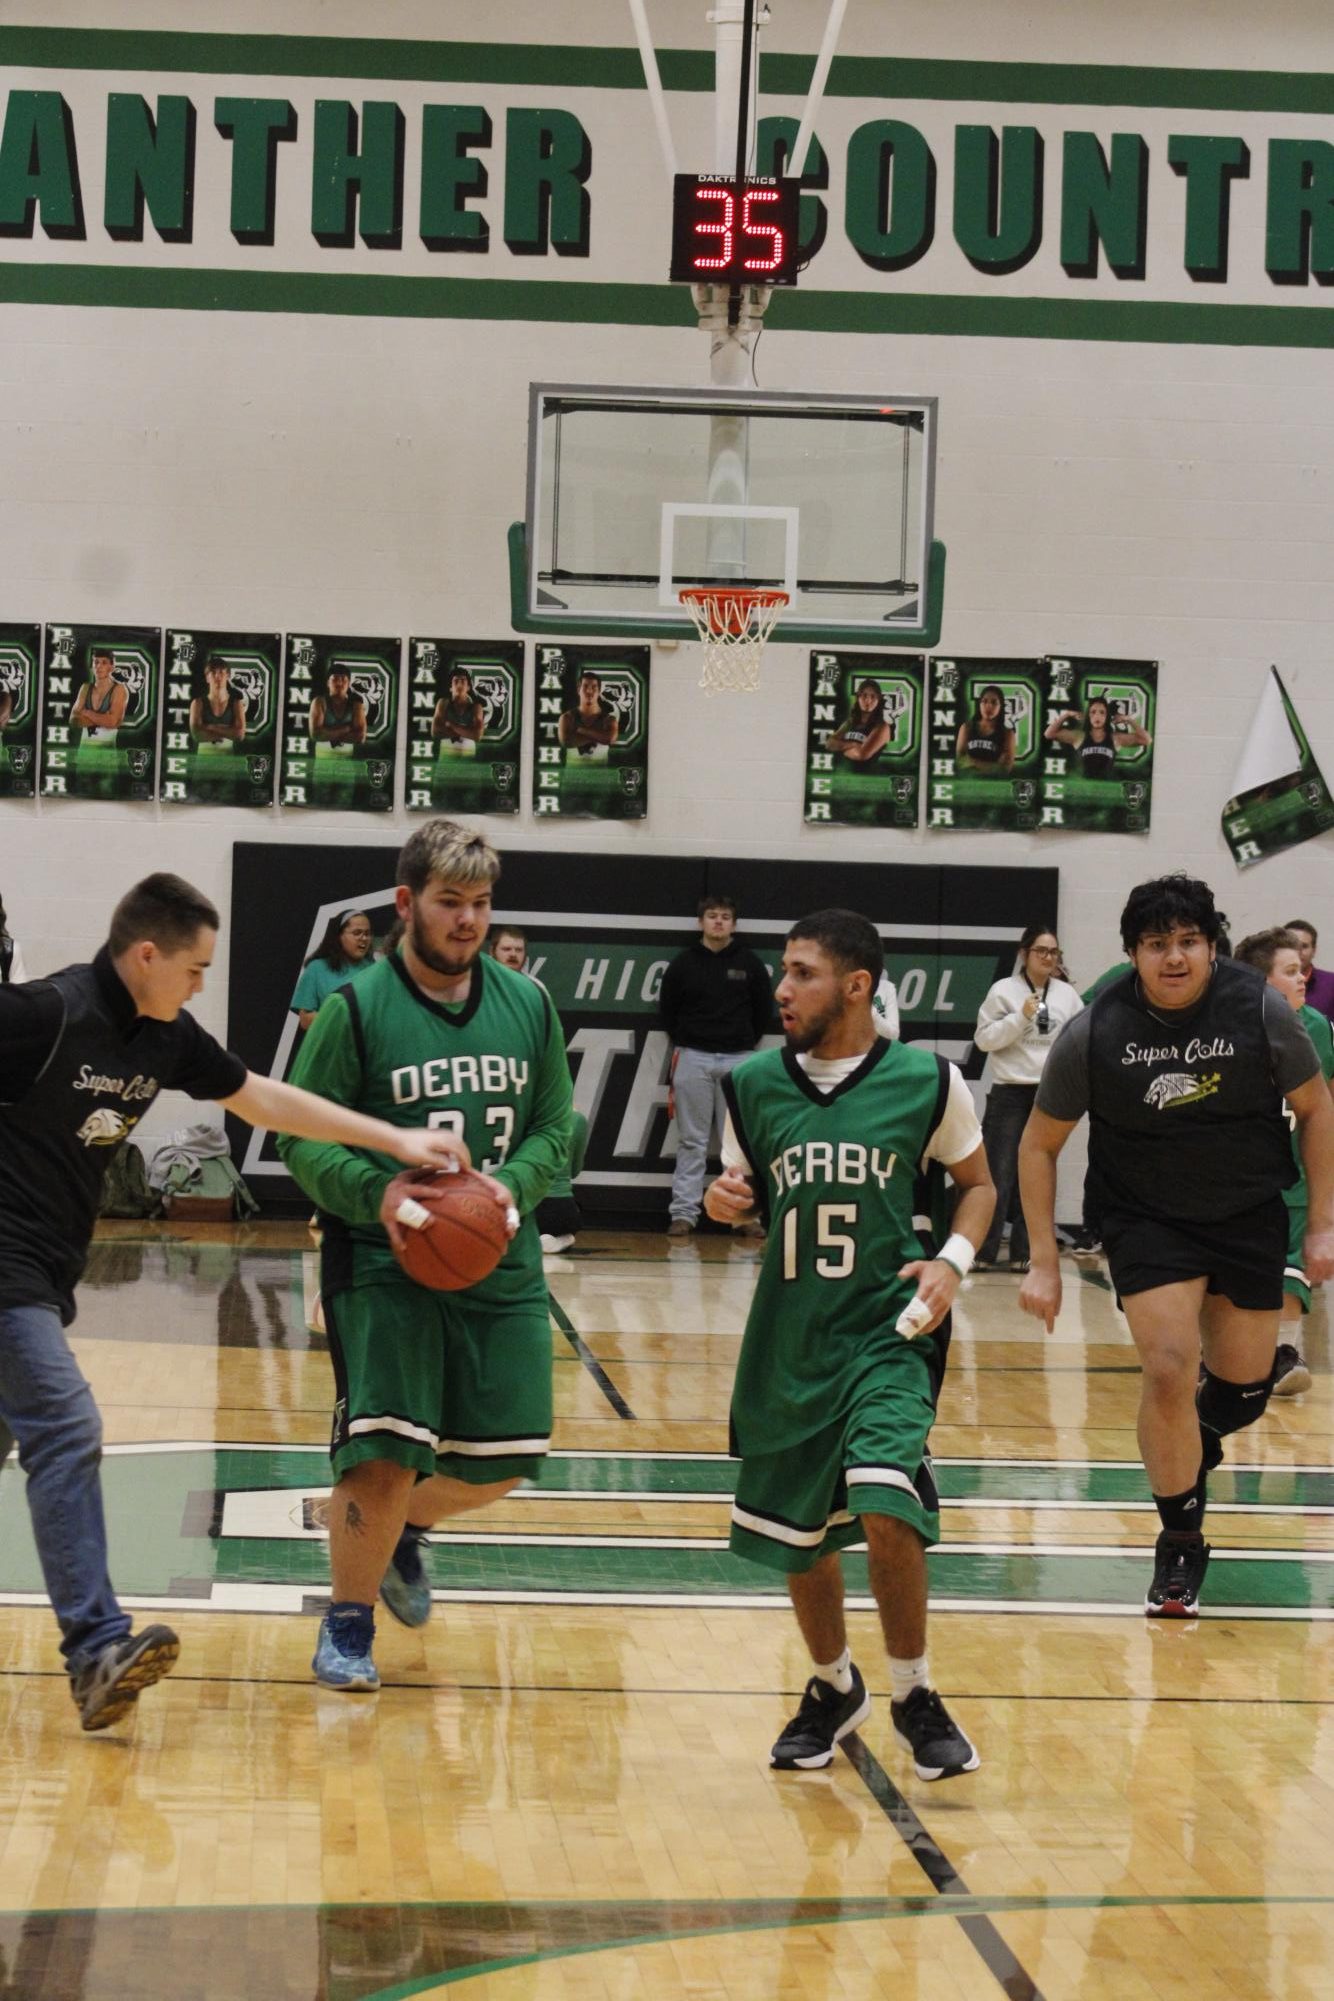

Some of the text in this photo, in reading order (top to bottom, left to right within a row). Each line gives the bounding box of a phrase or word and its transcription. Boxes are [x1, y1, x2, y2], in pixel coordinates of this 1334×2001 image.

[0, 89, 593, 258] ANTHER
[694, 190, 783, 269] 35
[698, 174, 777, 185] DAKTRNICS
[45, 627, 72, 793] PANTHER
[164, 634, 192, 799] PANTHER
[284, 638, 312, 803] PANTHER
[410, 642, 437, 807] PANTHER
[538, 648, 562, 813] PANTHER
[809, 655, 837, 819] PANTHER
[931, 661, 957, 825] PANTHER
[574, 957, 671, 1002] HIG
[72, 1064, 124, 1096] Super
[391, 1054, 528, 1105] DERBY
[1121, 1037, 1235, 1067] Super Colts
[769, 1141, 897, 1197] DERBY
[784, 1203, 857, 1280] 15
